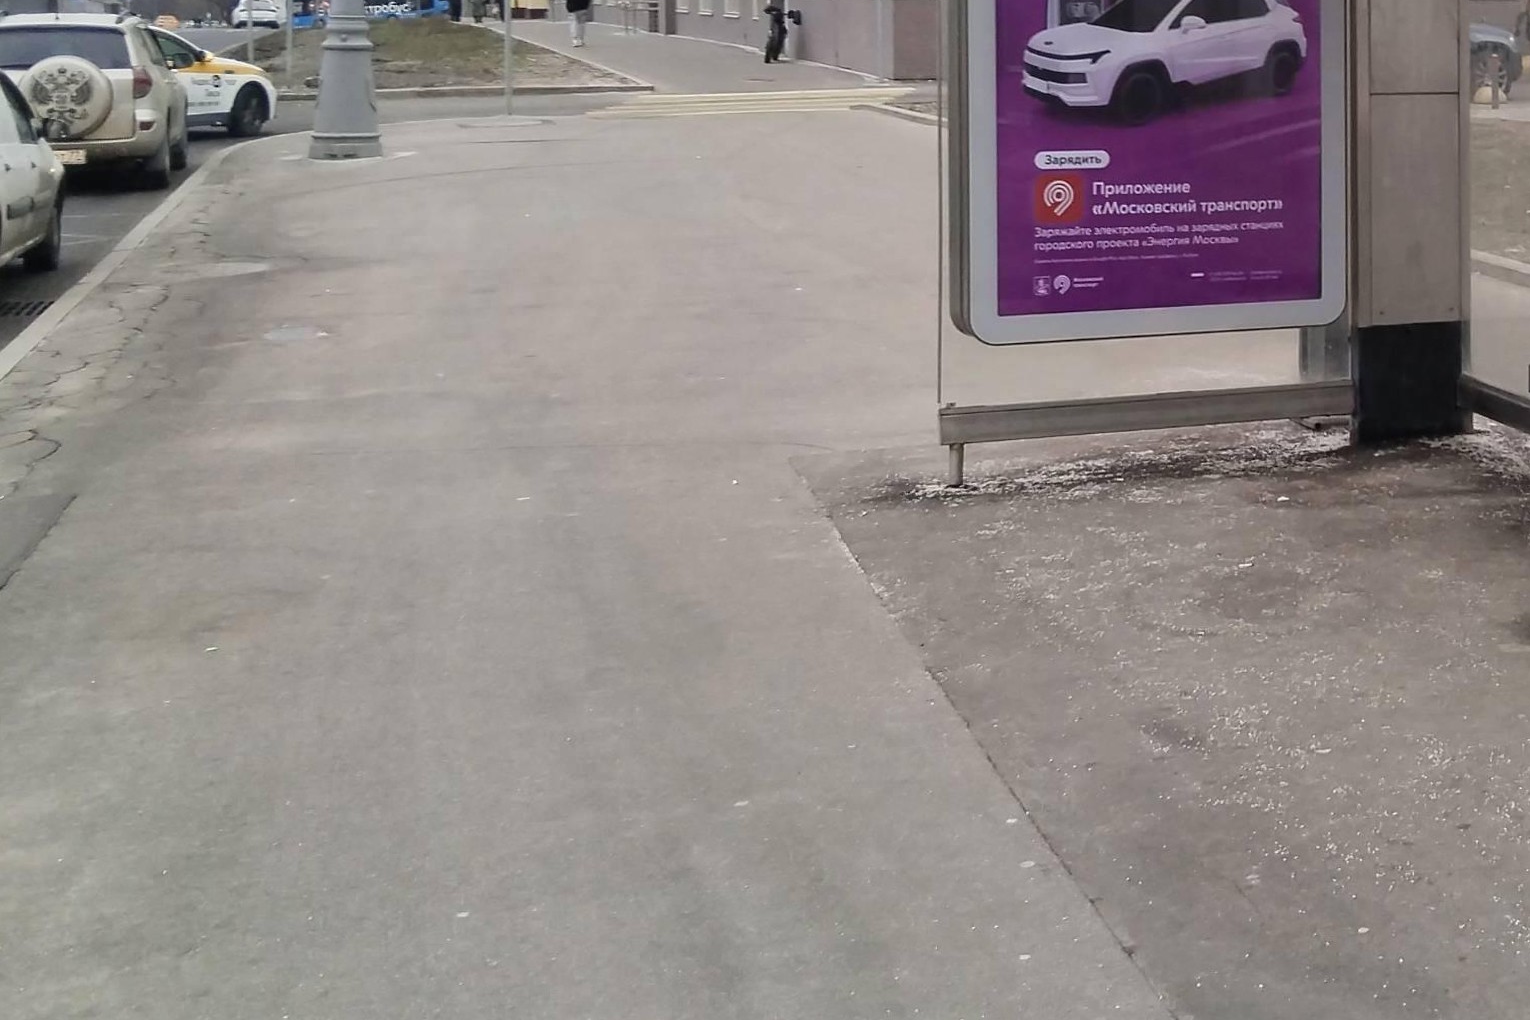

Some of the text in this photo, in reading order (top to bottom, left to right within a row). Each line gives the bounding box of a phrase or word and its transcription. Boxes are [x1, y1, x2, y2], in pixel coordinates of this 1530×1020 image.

[1043, 153, 1103, 168] Зарядить
[1092, 181, 1191, 198] Приложение
[1092, 199, 1283, 216] «Московский транспорт»
